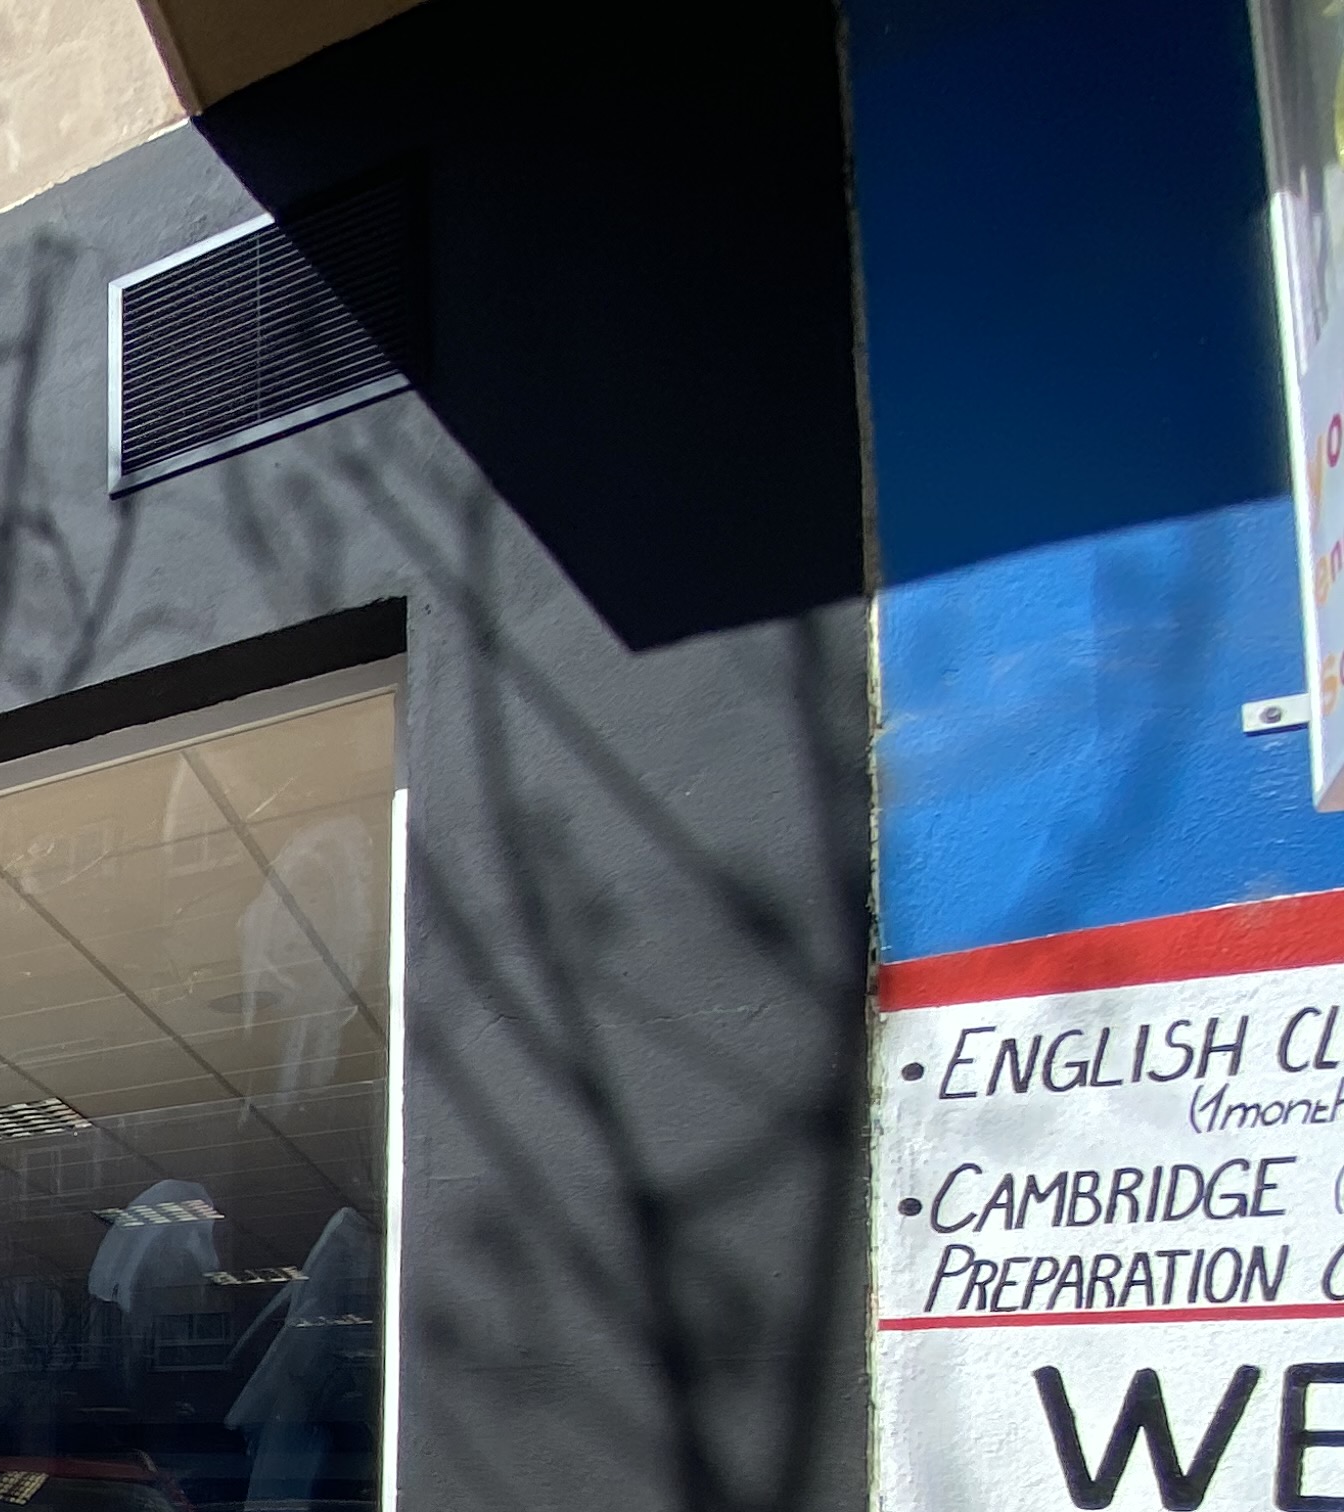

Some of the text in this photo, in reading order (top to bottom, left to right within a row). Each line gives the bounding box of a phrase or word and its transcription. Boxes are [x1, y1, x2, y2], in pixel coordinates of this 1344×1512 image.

[939, 1014, 1250, 1100] ENGLISH
[930, 1155, 1298, 1234] CAMBRIDGE
[923, 1243, 1290, 1313] PREPARATION
